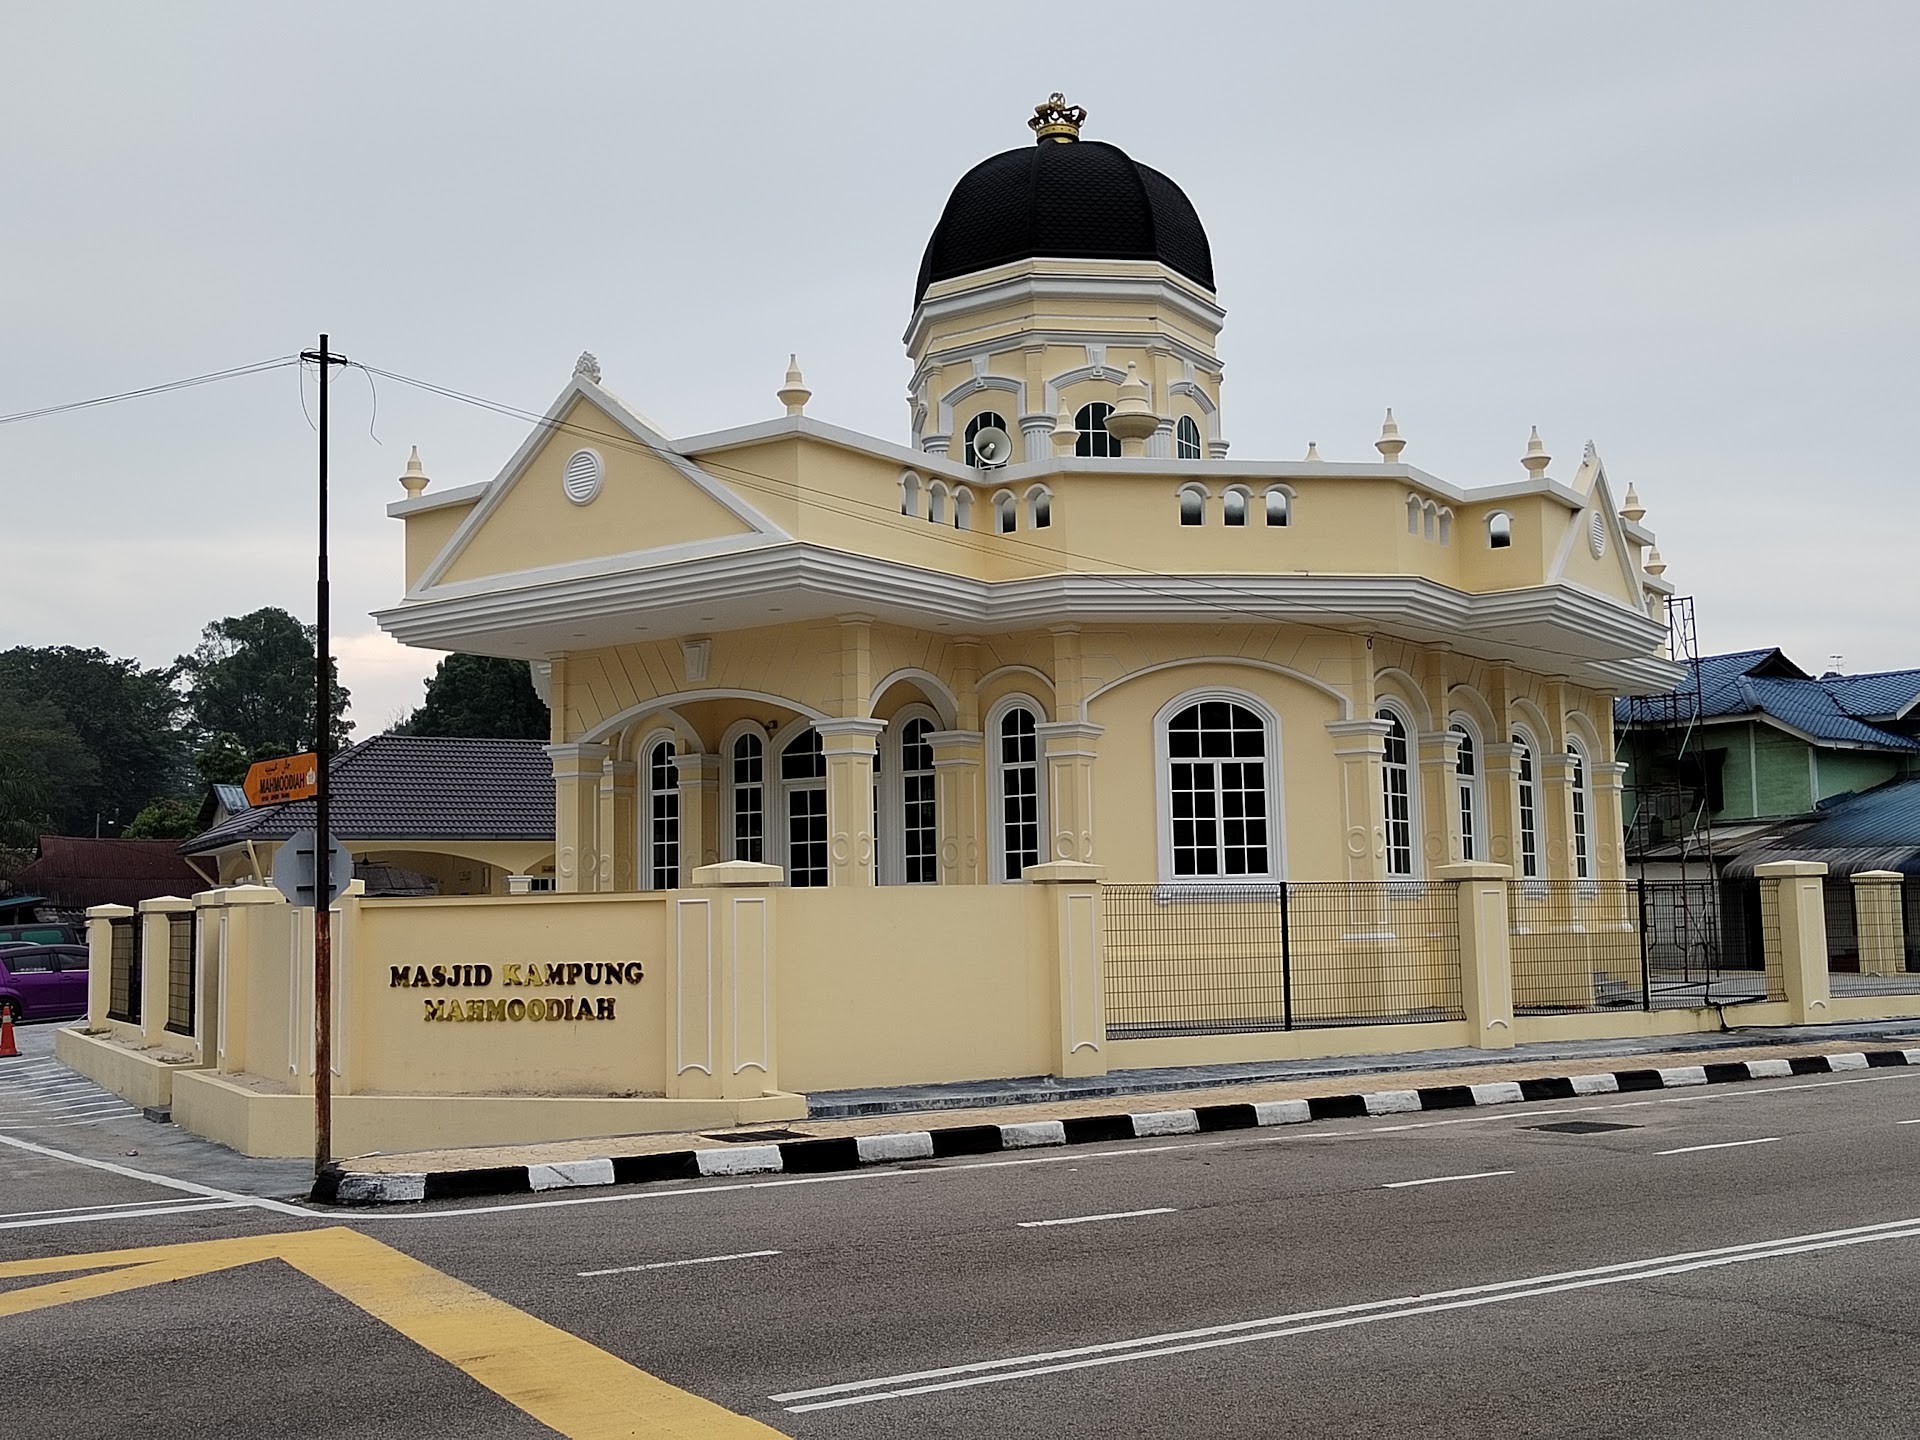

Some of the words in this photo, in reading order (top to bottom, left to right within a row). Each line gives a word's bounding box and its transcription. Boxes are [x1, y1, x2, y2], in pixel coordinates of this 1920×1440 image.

[260, 773, 305, 793] MAHMOODIAH
[389, 964, 493, 988] MASJID
[502, 961, 644, 986] KAMPUNG
[423, 997, 616, 1022] MAHMOODIAH
